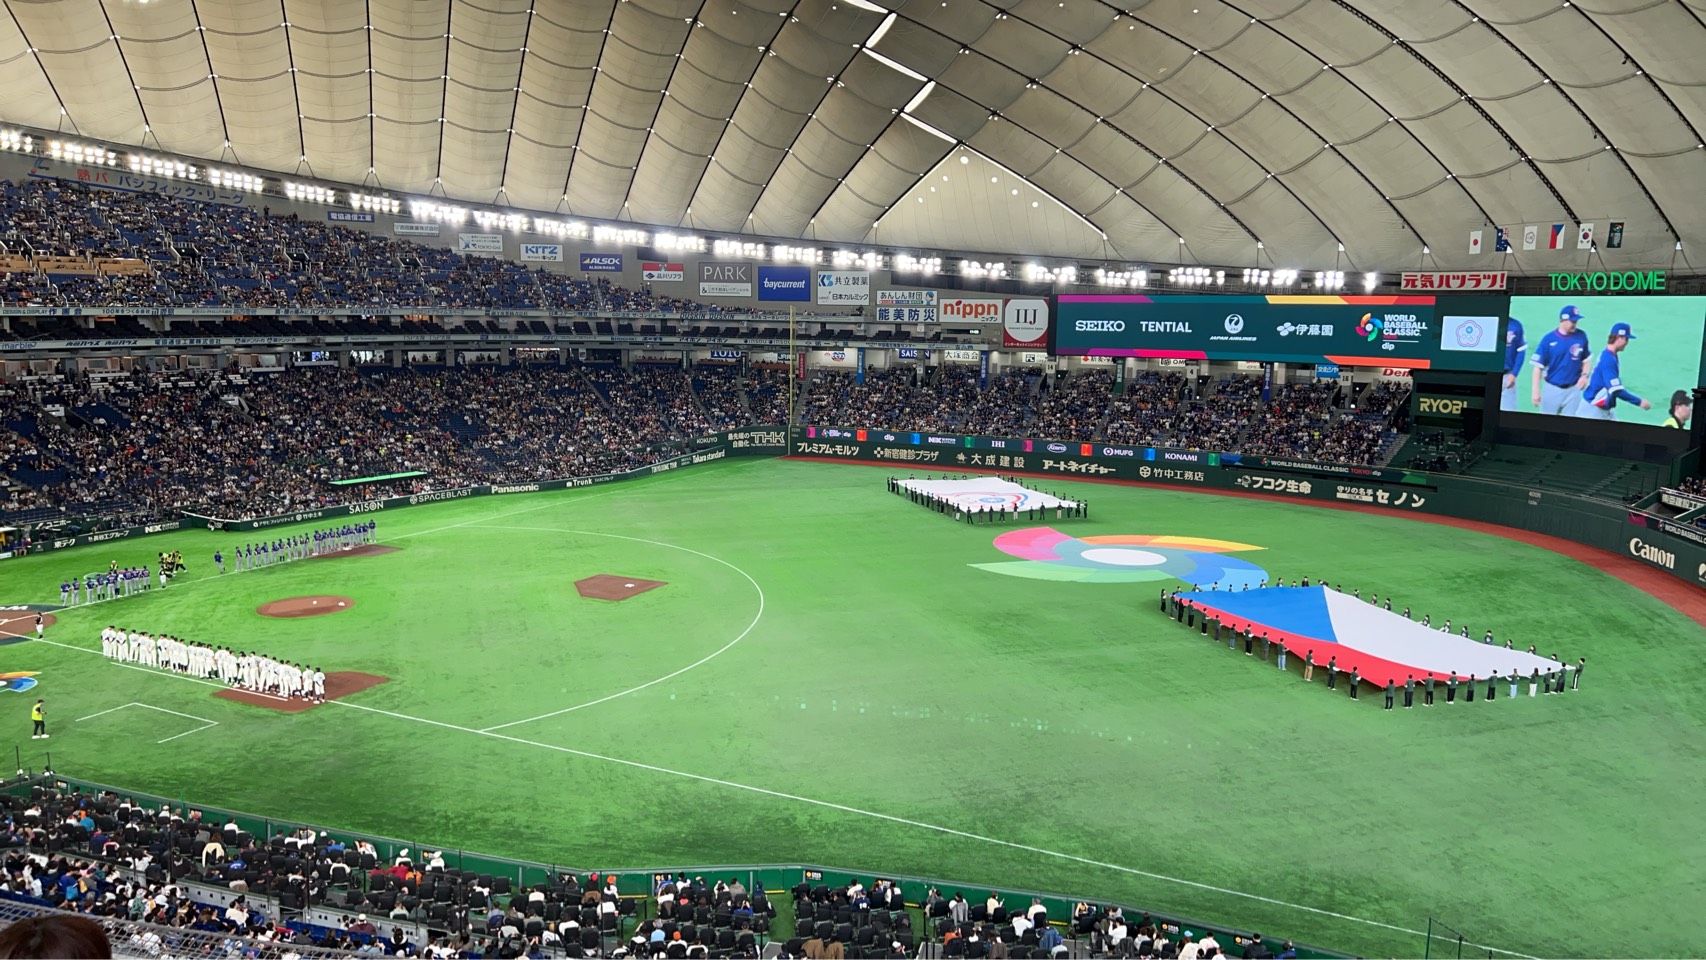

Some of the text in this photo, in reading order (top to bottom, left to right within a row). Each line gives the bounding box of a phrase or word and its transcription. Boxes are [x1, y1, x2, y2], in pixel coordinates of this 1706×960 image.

[119, 175, 244, 205] パシフィック・リーグ
[525, 245, 558, 255] KITZ
[590, 257, 620, 265] ALSOK
[704, 266, 746, 281] PARK
[764, 277, 806, 290] baycurrent
[834, 276, 869, 286] 共立製薬
[1403, 272, 1506, 289] 元気ハツラツ!
[1548, 270, 1666, 291] TOKYO DOME
[880, 292, 923, 300] あんしん財団
[878, 308, 935, 321] 能美防災
[943, 299, 998, 319] nippn
[1015, 308, 1039, 325] IIJ
[1384, 314, 1417, 322] WORLD
[1075, 320, 1192, 333] SEIKO TENTIAL
[1295, 324, 1334, 337] 伊藤園
[1383, 321, 1428, 329] BASEBALL
[1381, 342, 1395, 351] dip
[712, 350, 741, 358] TOTO
[945, 351, 979, 360] 大塚商会
[750, 432, 785, 444] THK
[991, 440, 1005, 448] IHI
[797, 442, 859, 456] プレミアム・モルツ
[692, 454, 707, 463] Takara
[706, 449, 725, 461] standard
[971, 453, 1025, 468] 大成建設
[1165, 452, 1198, 462] KONAMI
[1042, 459, 1116, 474] アートネイチャー
[1293, 462, 1323, 470] BASEBALL
[1323, 465, 1349, 473] CLASSIC
[1153, 467, 1205, 481] 竹中工務店
[491, 484, 539, 494] Panasonic
[573, 479, 593, 487] Trunk
[1252, 476, 1312, 494] フコク生命
[1376, 489, 1426, 507] セノン
[349, 501, 384, 515] SAISON
[54, 538, 76, 549] 東テク
[1629, 537, 1675, 569] Canon
